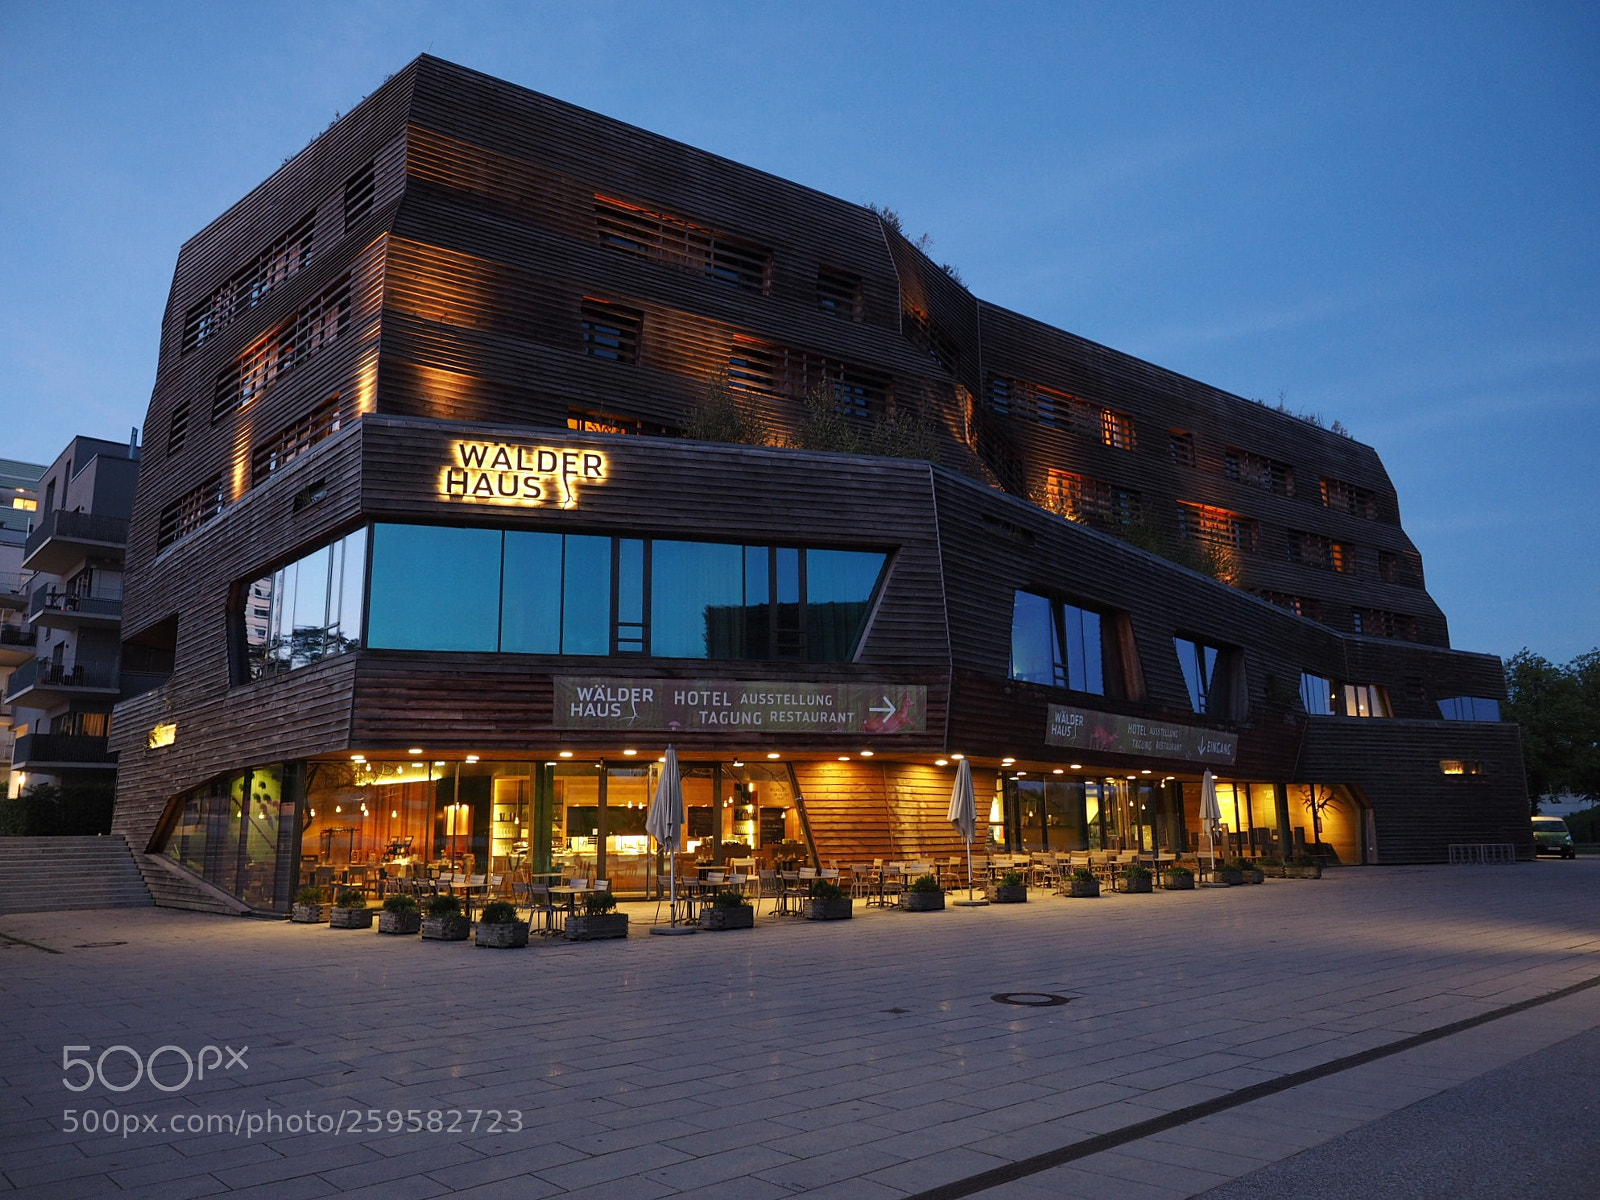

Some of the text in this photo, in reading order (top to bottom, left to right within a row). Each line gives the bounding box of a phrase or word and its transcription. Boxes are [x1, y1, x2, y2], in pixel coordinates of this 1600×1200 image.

[459, 441, 603, 477] WÄLDER
[446, 470, 541, 498] HAUS
[577, 685, 654, 702] WÄLDER
[674, 691, 832, 706] HOTEL AUSSTELLUNG
[570, 703, 621, 717] HAUS
[699, 711, 855, 725] TAGUNG RESTAURANT
[1055, 710, 1084, 727] WÄLDER
[1052, 724, 1072, 737] HAUS
[1128, 723, 1147, 736] HOTEL
[1207, 740, 1232, 756] EINGANG
